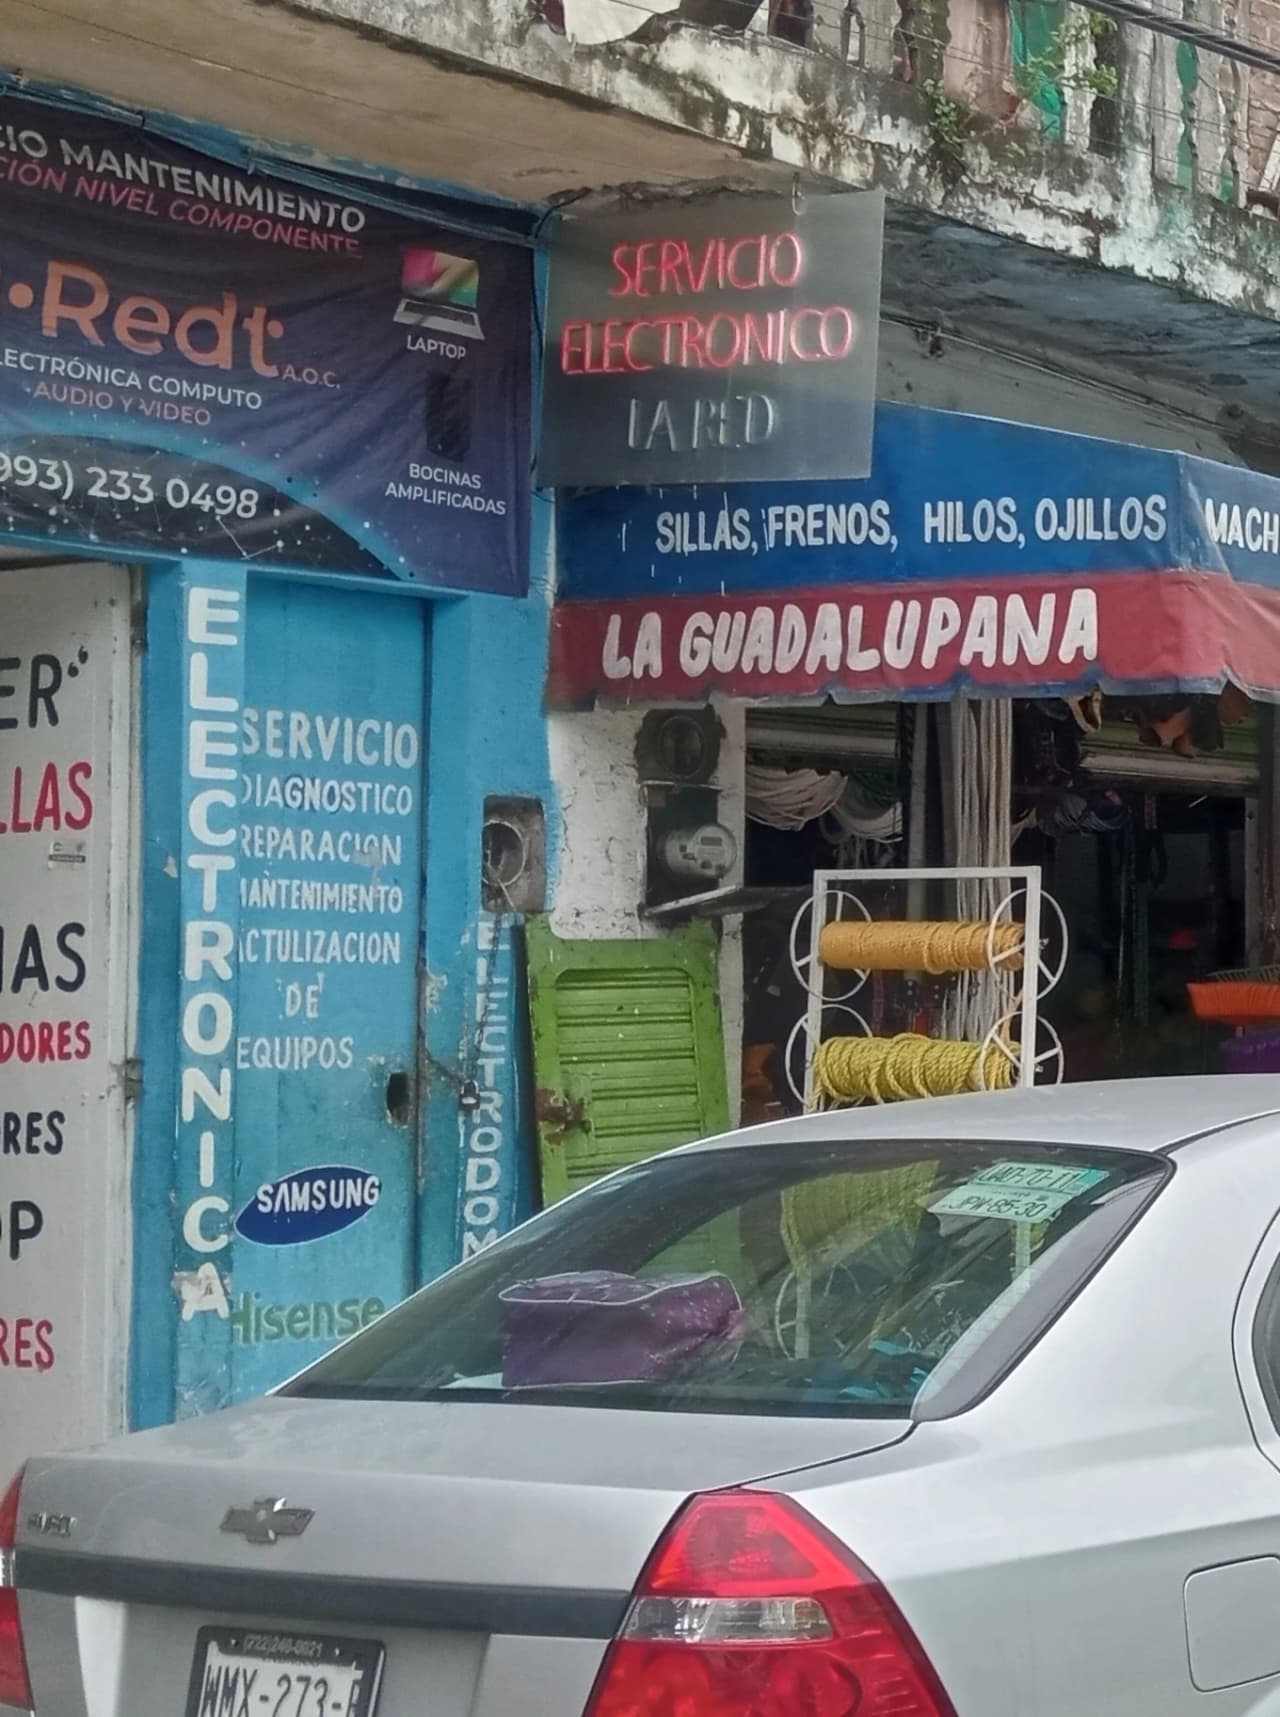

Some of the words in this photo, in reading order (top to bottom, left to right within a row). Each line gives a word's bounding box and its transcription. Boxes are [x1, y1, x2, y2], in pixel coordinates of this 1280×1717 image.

[0, 125, 48, 158] IO
[59, 139, 365, 233] MANTENIMIENTO
[75, 176, 158, 216] NIVEL
[169, 201, 363, 259] COMPONENTE
[610, 233, 801, 296] SERVICIO
[407, 335, 466, 360] LAPTOP
[561, 304, 853, 375] ELECTRONICO
[149, 374, 262, 410] COMPUTO
[282, 364, 341, 390] A.O.C.
[33, 381, 112, 410] AUDIO
[122, 396, 134, 413] Y
[140, 399, 211, 427] VIDEO
[87, 466, 154, 506] 233
[166, 478, 259, 519] 0498
[385, 482, 506, 515] AMPLIFICADAS
[409, 463, 481, 489] BOCINAS
[656, 509, 758, 555] SILLAS,
[767, 500, 898, 552] FRENOS,
[924, 497, 1025, 549] HILOS,
[1034, 494, 1167, 542] OJILLOS
[602, 611, 662, 680] LA
[679, 588, 1098, 678] GUADALUPANA
[242, 708, 418, 769] SERVICIO
[180, 586, 241, 1322] ELECTRONICA
[285, 983, 319, 1018] DE
[237, 1036, 353, 1071] EQUIPOS
[256, 1175, 380, 1213] SAMSUNG
